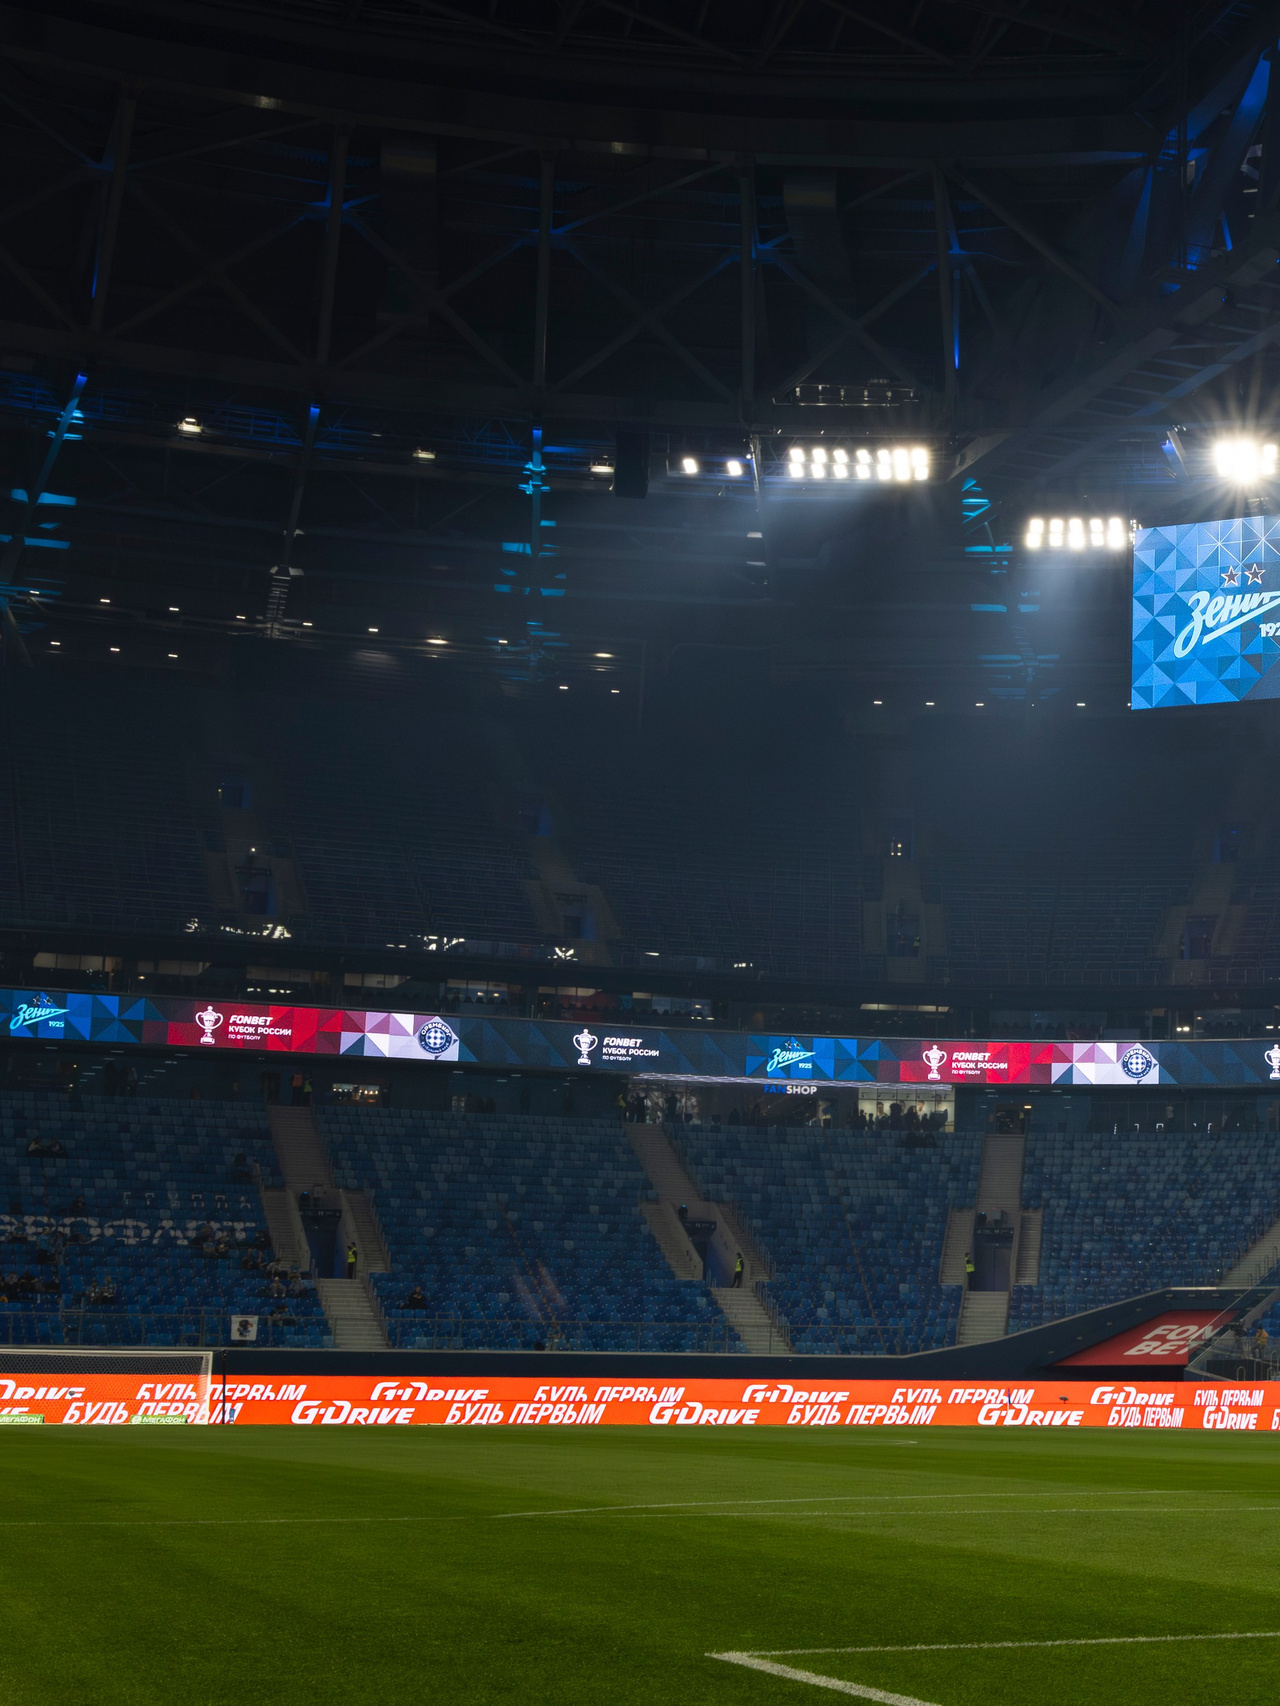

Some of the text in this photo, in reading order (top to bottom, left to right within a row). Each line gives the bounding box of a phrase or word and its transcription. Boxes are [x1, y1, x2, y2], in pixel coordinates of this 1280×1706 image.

[229, 1015, 273, 1026] FONBET
[228, 1026, 292, 1036] КУБОК РОССИИ
[603, 1037, 643, 1047] FONBET
[629, 1049, 660, 1057] РОССИИ
[952, 1052, 991, 1061] FONBET
[1142, 1324, 1223, 1340] FON
[1123, 1340, 1205, 1355] BET
[62, 1402, 129, 1425] БУДЬ
[443, 1403, 607, 1425] БУДЬ ПЕРВЫМ
[786, 1404, 937, 1425] БУДЬ ПЕРВЫМ
[1107, 1406, 1185, 1428] БУДЬ ПЕРВЫМ
